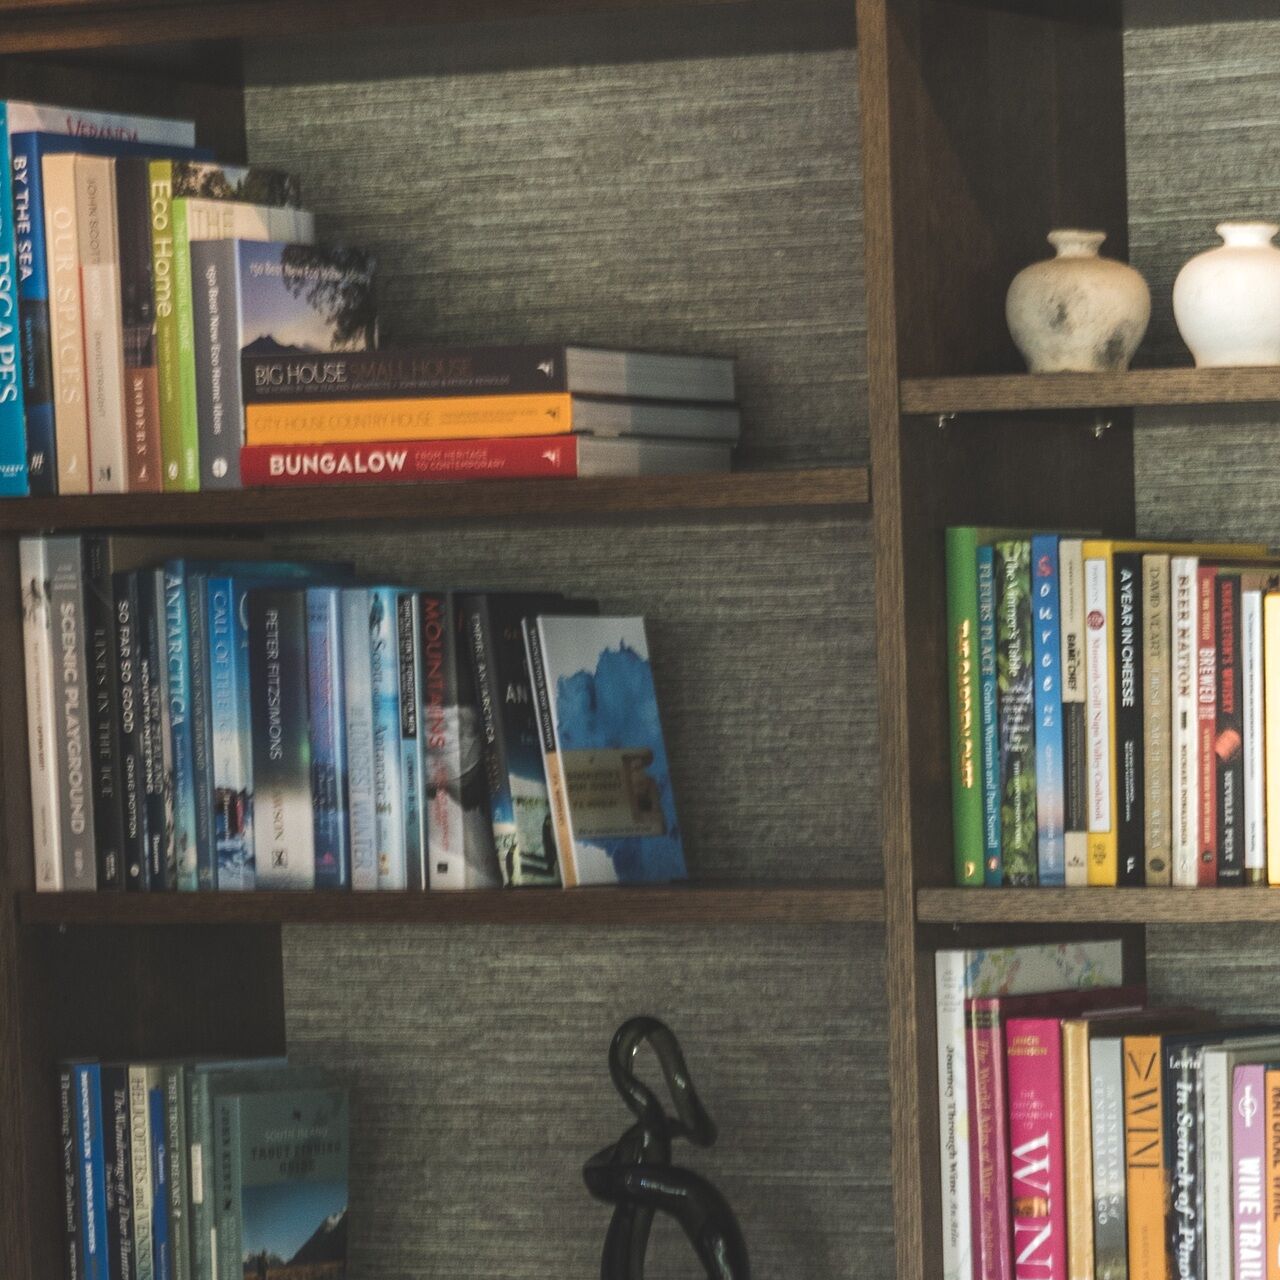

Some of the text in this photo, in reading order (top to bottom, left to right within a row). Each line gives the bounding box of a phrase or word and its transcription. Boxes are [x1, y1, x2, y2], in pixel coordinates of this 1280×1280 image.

[13, 155, 35, 283] BY THE SEA
[149, 178, 174, 320] Eco Home
[52, 206, 82, 404] OUR SPACES
[132, 377, 148, 456] MODERN
[269, 451, 408, 477] BUNGALOW
[117, 600, 134, 735] SO FAR SO GOOD
[164, 574, 185, 728] ANTARCTICA
[264, 608, 284, 761] PETER FITZSIMONS
[424, 598, 447, 750] MOUNTAINS
[1119, 569, 1136, 708] A YEAR IN CHEESE
[1176, 575, 1191, 698] BEER NATION
[1198, 647, 1217, 704] BREWED
[58, 601, 86, 836] SCENIC PLAYGROUND
[132, 1077, 149, 1185] HELICOPTERS
[944, 1045, 960, 1195] Journey Through Wine
[1236, 1156, 1261, 1215] WINE
